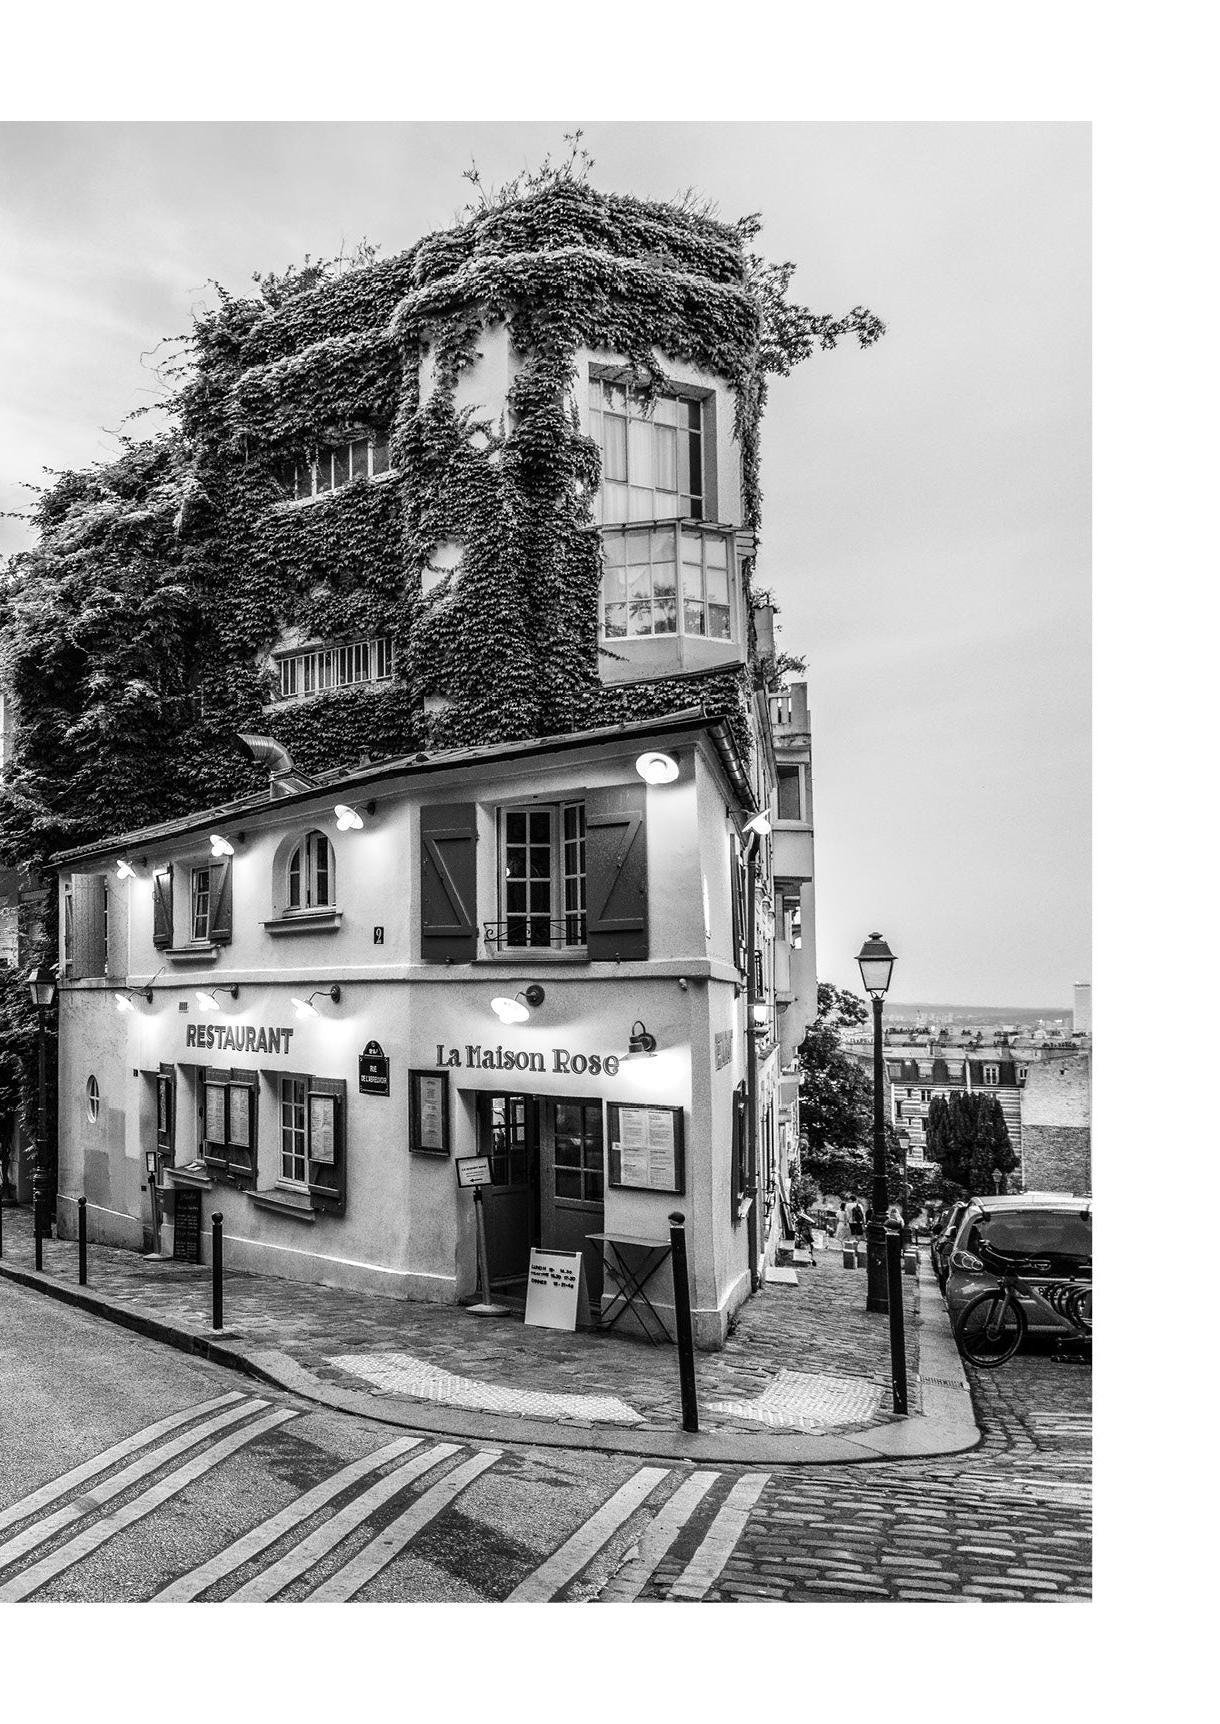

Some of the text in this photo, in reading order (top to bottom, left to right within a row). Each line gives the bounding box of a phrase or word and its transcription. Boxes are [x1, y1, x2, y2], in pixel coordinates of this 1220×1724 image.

[186, 1024, 294, 1055] RESTAURANT
[436, 1044, 620, 1076] La Maison Rose
